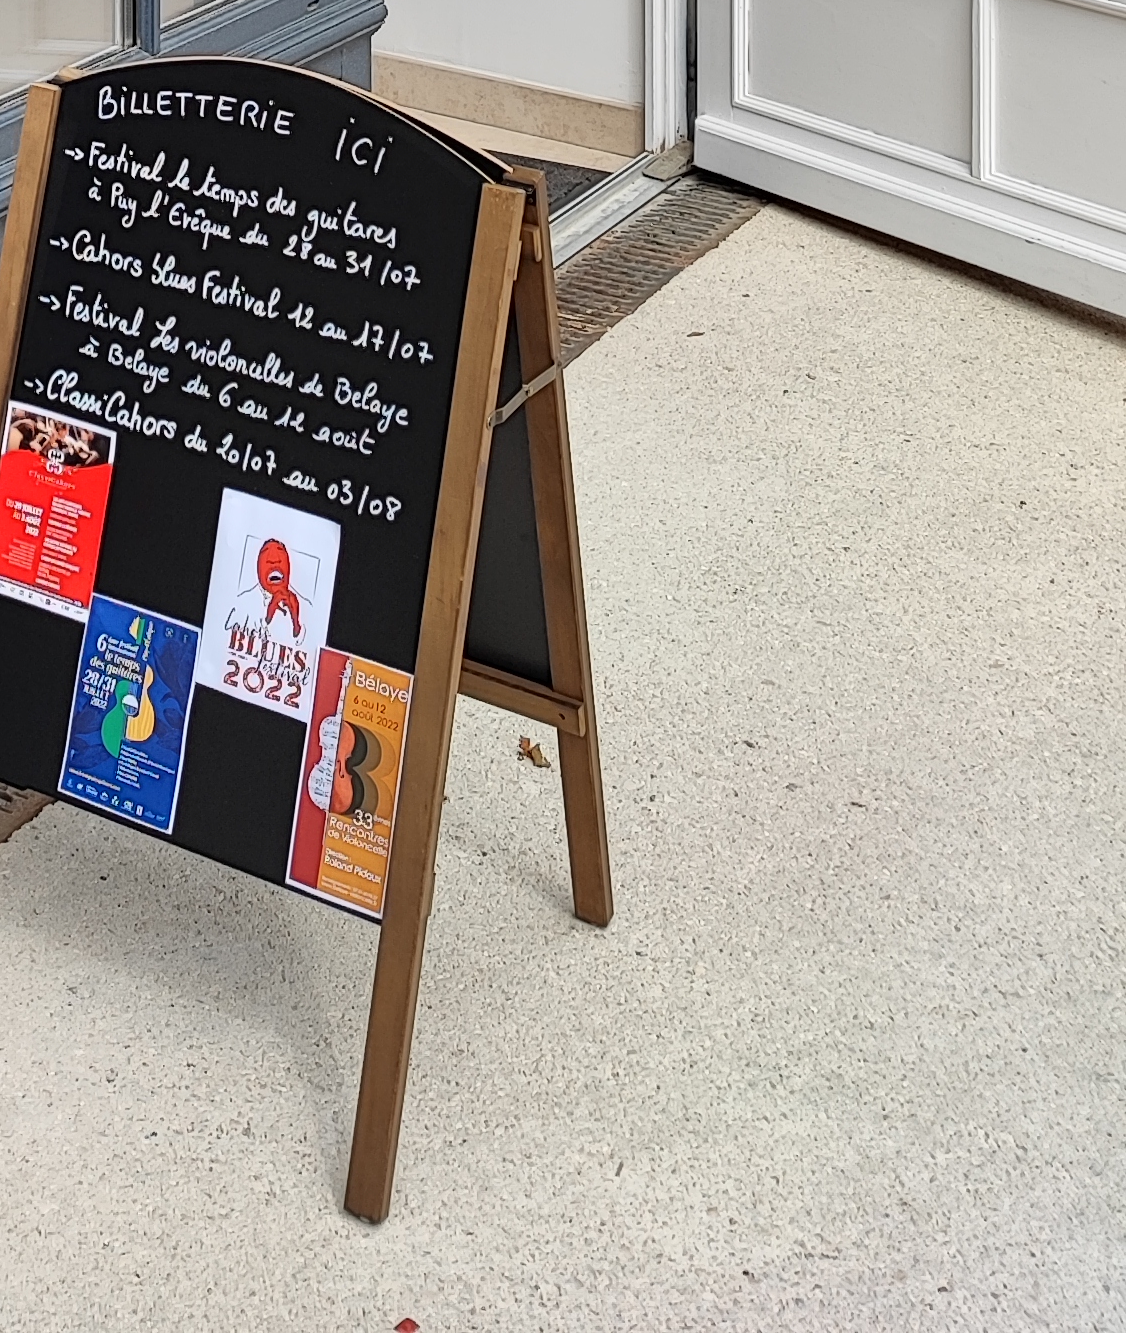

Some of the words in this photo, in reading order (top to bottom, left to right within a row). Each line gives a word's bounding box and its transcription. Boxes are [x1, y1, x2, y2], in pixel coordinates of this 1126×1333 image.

[88, 141, 165, 183] Festival
[166, 157, 190, 191] le
[193, 164, 259, 217] temps
[266, 187, 296, 216] des
[301, 201, 397, 249] guitares
[88, 177, 101, 202] à
[110, 182, 138, 228] Puy
[239, 223, 269, 247] du
[283, 235, 313, 260] 28
[313, 253, 337, 270] au
[72, 229, 143, 277] Cahors
[203, 270, 281, 318] Festival
[288, 302, 314, 329] 12
[318, 322, 347, 341] au
[351, 320, 434, 364] 17/07
[65, 285, 144, 337] Festival
[185, 339, 294, 388] violoncelles
[299, 373, 324, 396] de
[334, 377, 408, 433] Belaye
[79, 335, 100, 358] à
[107, 343, 170, 394] Belaye
[181, 373, 212, 398] du
[218, 382, 238, 407] 6
[237, 400, 268, 420] au
[274, 406, 304, 432] 12
[184, 425, 207, 452] du
[216, 432, 276, 475] 20/07
[282, 471, 319, 492] au
[327, 479, 402, 521] 03/08
[97, 634, 108, 651] 6
[228, 629, 307, 673] BLUES
[90, 656, 105, 671] des
[106, 664, 143, 685] guitares
[114, 654, 140, 673] temps
[82, 669, 116, 692] 28/31
[224, 659, 301, 709] 2022
[355, 671, 409, 703] Bélaye
[90, 696, 108, 710] 2022
[353, 695, 359, 705] 6
[361, 699, 374, 710] au
[376, 701, 387, 714] 12
[351, 709, 374, 722] août
[376, 716, 399, 732] 2022
[329, 816, 389, 848] Rencontres
[353, 809, 373, 829] 33
[327, 829, 340, 839] de
[342, 832, 388, 858] Violoncelle
[324, 855, 353, 873] Roland
[354, 865, 381, 884] Pidoux
